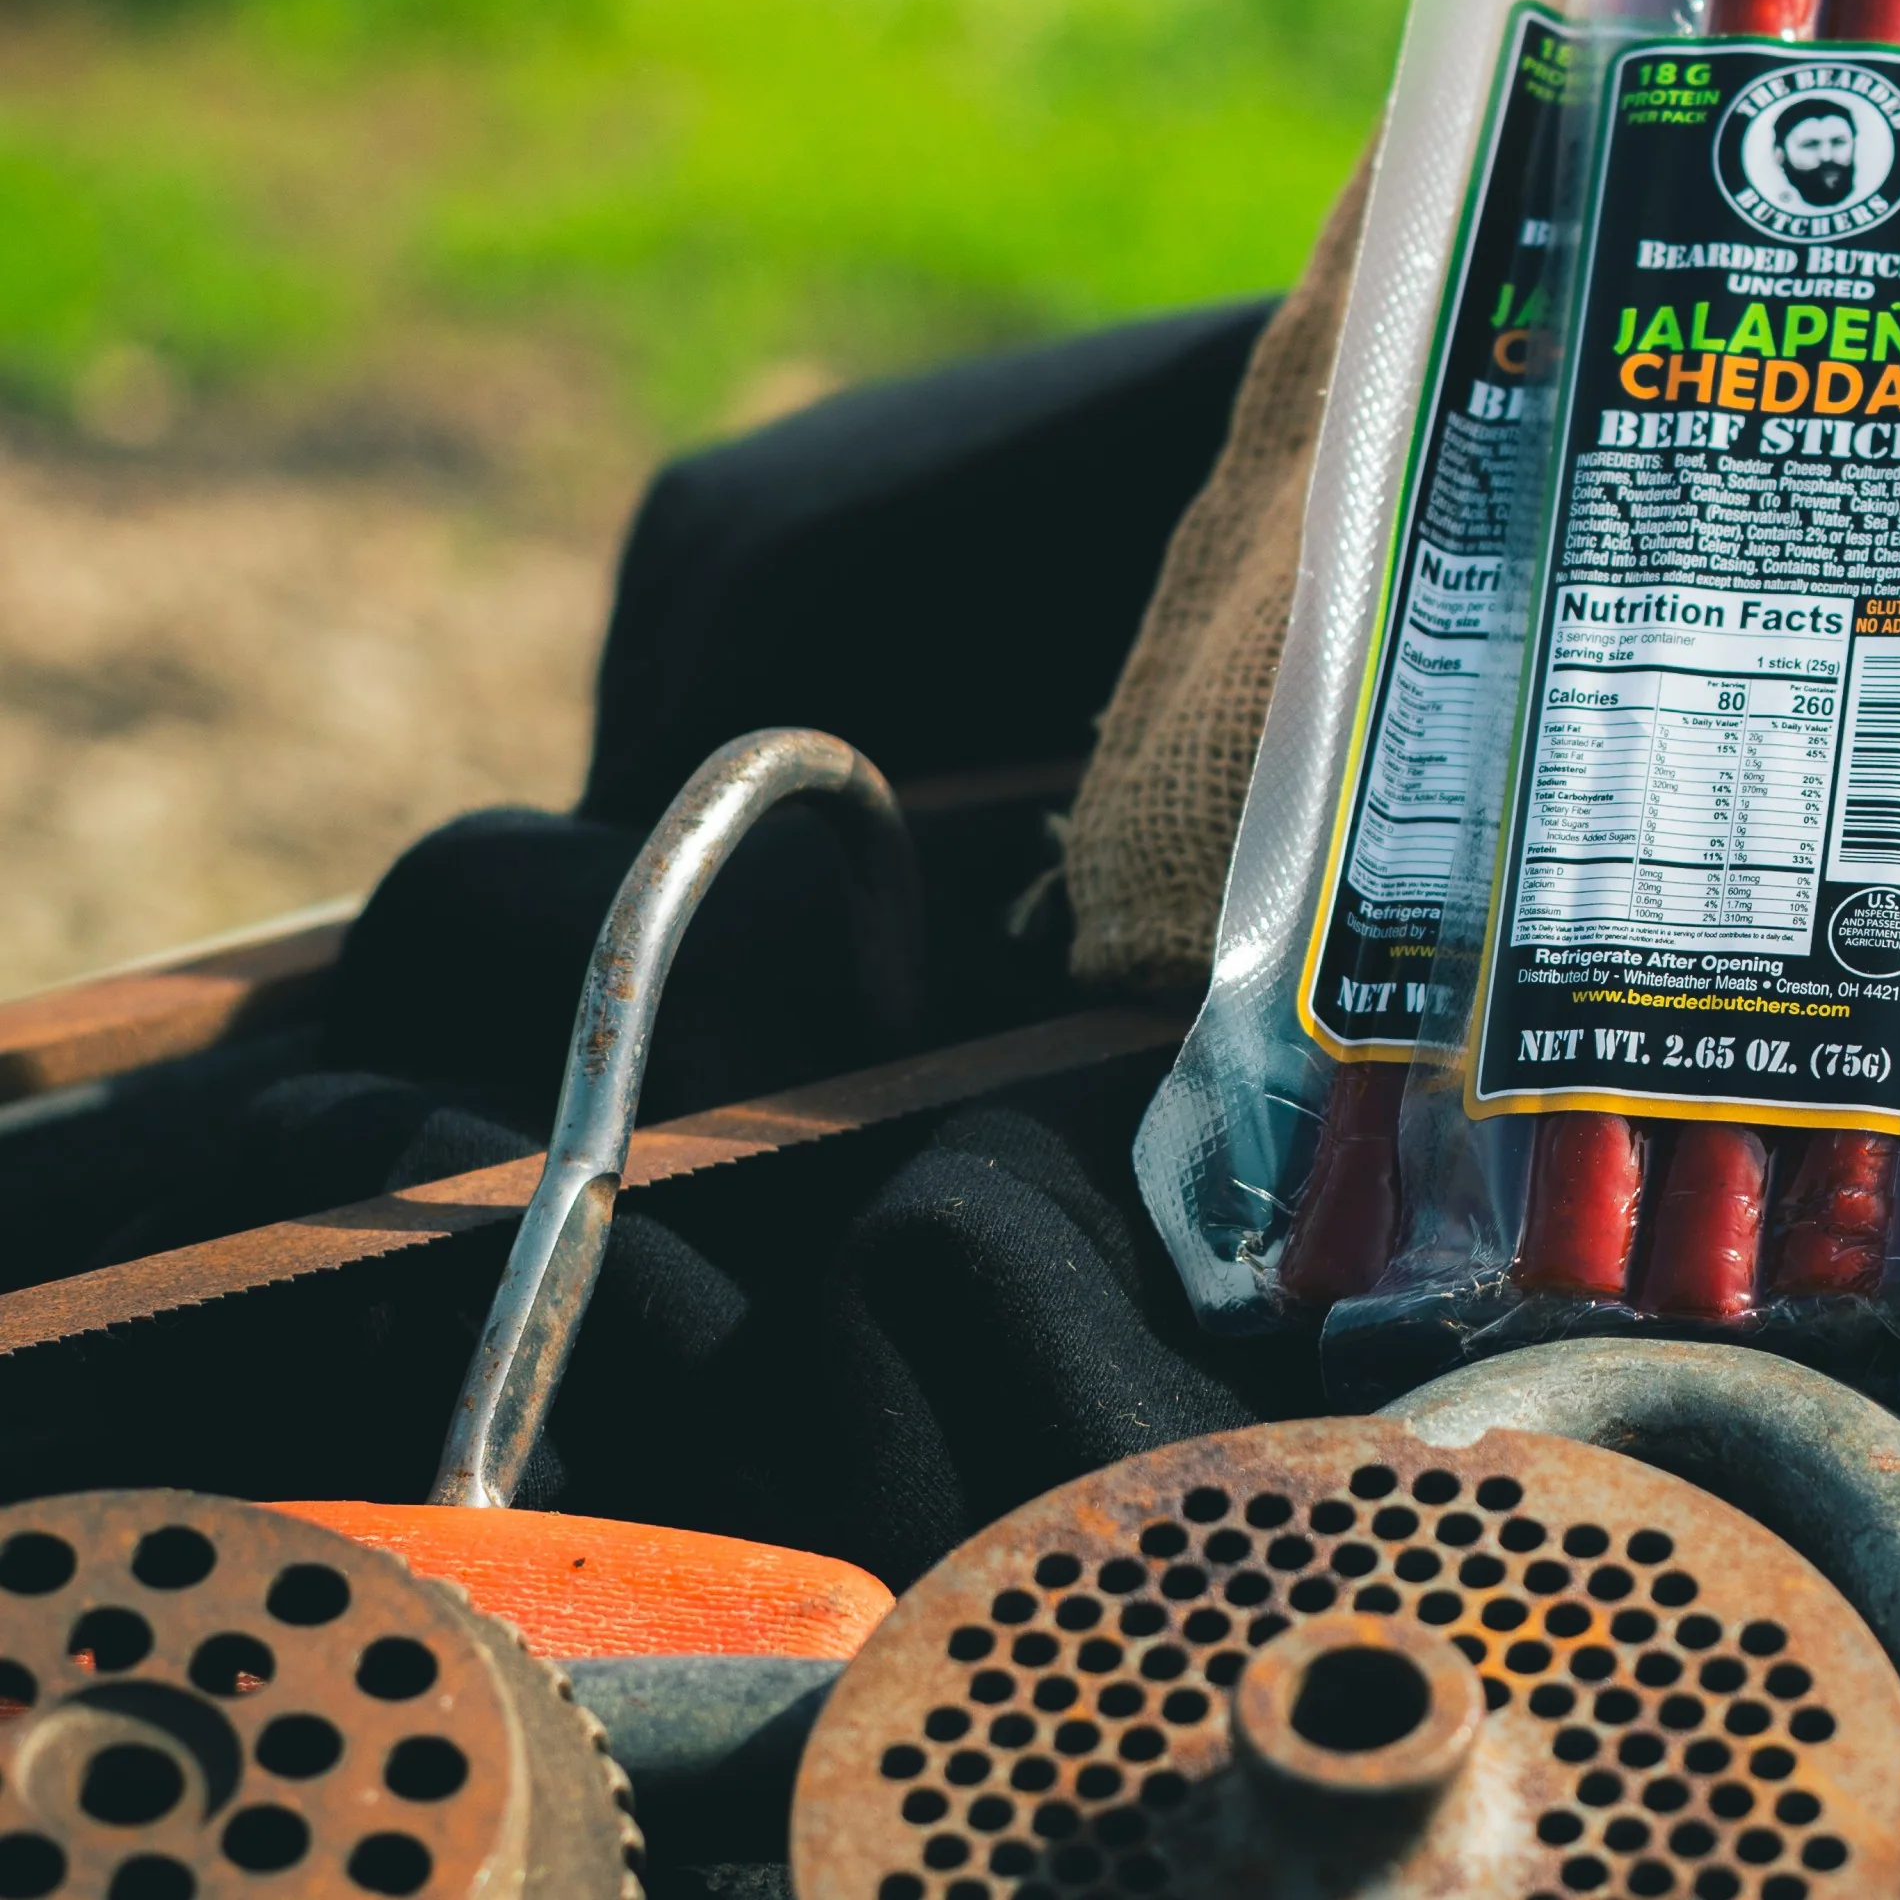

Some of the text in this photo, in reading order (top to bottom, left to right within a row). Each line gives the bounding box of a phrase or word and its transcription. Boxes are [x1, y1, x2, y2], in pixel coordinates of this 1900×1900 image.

[1640, 63, 1710, 85] 18 G
[1622, 89, 1720, 108] PROTEIN
[1736, 75, 1785, 119] THE
[1735, 187, 1890, 236] BUTCHERS
[1727, 274, 1875, 299] UNCURED
[1598, 410, 1745, 449] BEEF
[1562, 592, 1843, 634] Nutrition Facts
[1856, 618, 1883, 633] NO
[1402, 640, 1461, 670] Calories
[1548, 689, 1834, 715] Calories 80 260
[1535, 948, 1783, 976] Refrigerate After Opening
[1337, 976, 1396, 1013] NET
[1518, 968, 1588, 985] Distributed
[1592, 970, 1609, 984] by
[1624, 970, 1710, 989] Whitefeather
[1715, 976, 1757, 990] Meats
[1776, 979, 1833, 997] Creston,
[1838, 984, 1858, 998] OH
[1572, 989, 1850, 1017] www.beardedbutchers.com
[1518, 1029, 1584, 1062] NET
[1594, 1028, 1650, 1064] WT.
[1665, 1034, 1734, 1069] 2.65
[1746, 1038, 1797, 1074] OZ.
